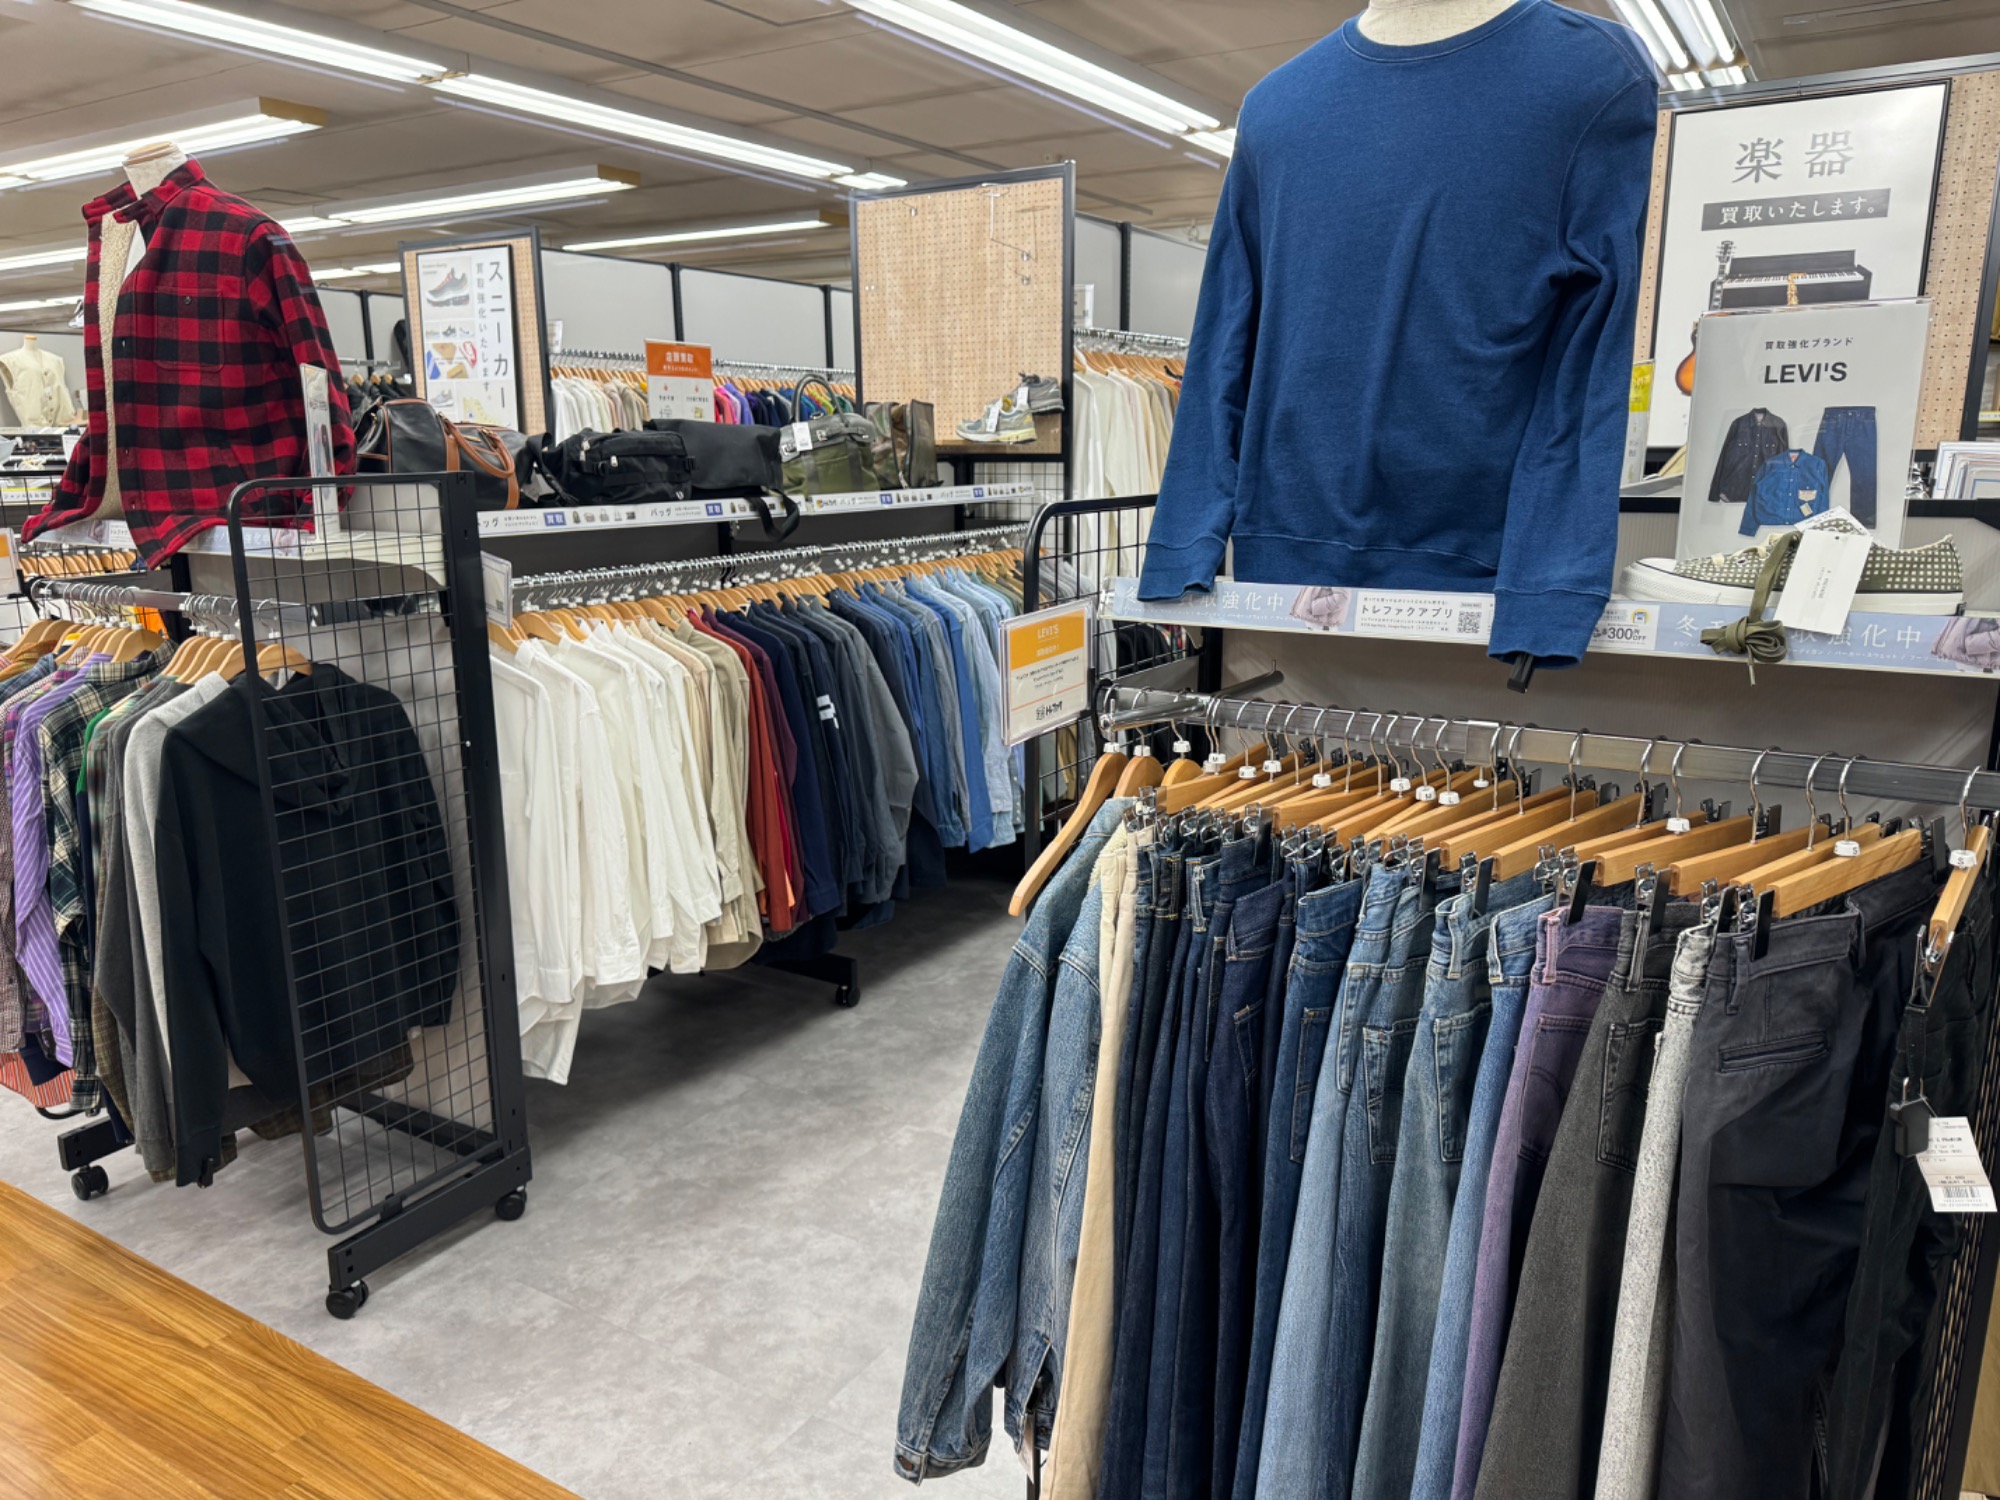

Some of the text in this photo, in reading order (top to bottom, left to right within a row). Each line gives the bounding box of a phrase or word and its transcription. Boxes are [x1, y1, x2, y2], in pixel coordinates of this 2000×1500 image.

[1732, 129, 1854, 184] 楽器
[1719, 196, 1875, 226] 買取いたします。
[488, 260, 508, 409] スニーカー
[1764, 337, 1854, 351] 買取強化ブランド
[1763, 361, 1848, 385] LEVI'S
[650, 507, 672, 517] バッグ
[478, 515, 500, 528] ッグ
[1361, 604, 1453, 619] トレファクアプリ
[1037, 624, 1059, 639] LEVI'S
